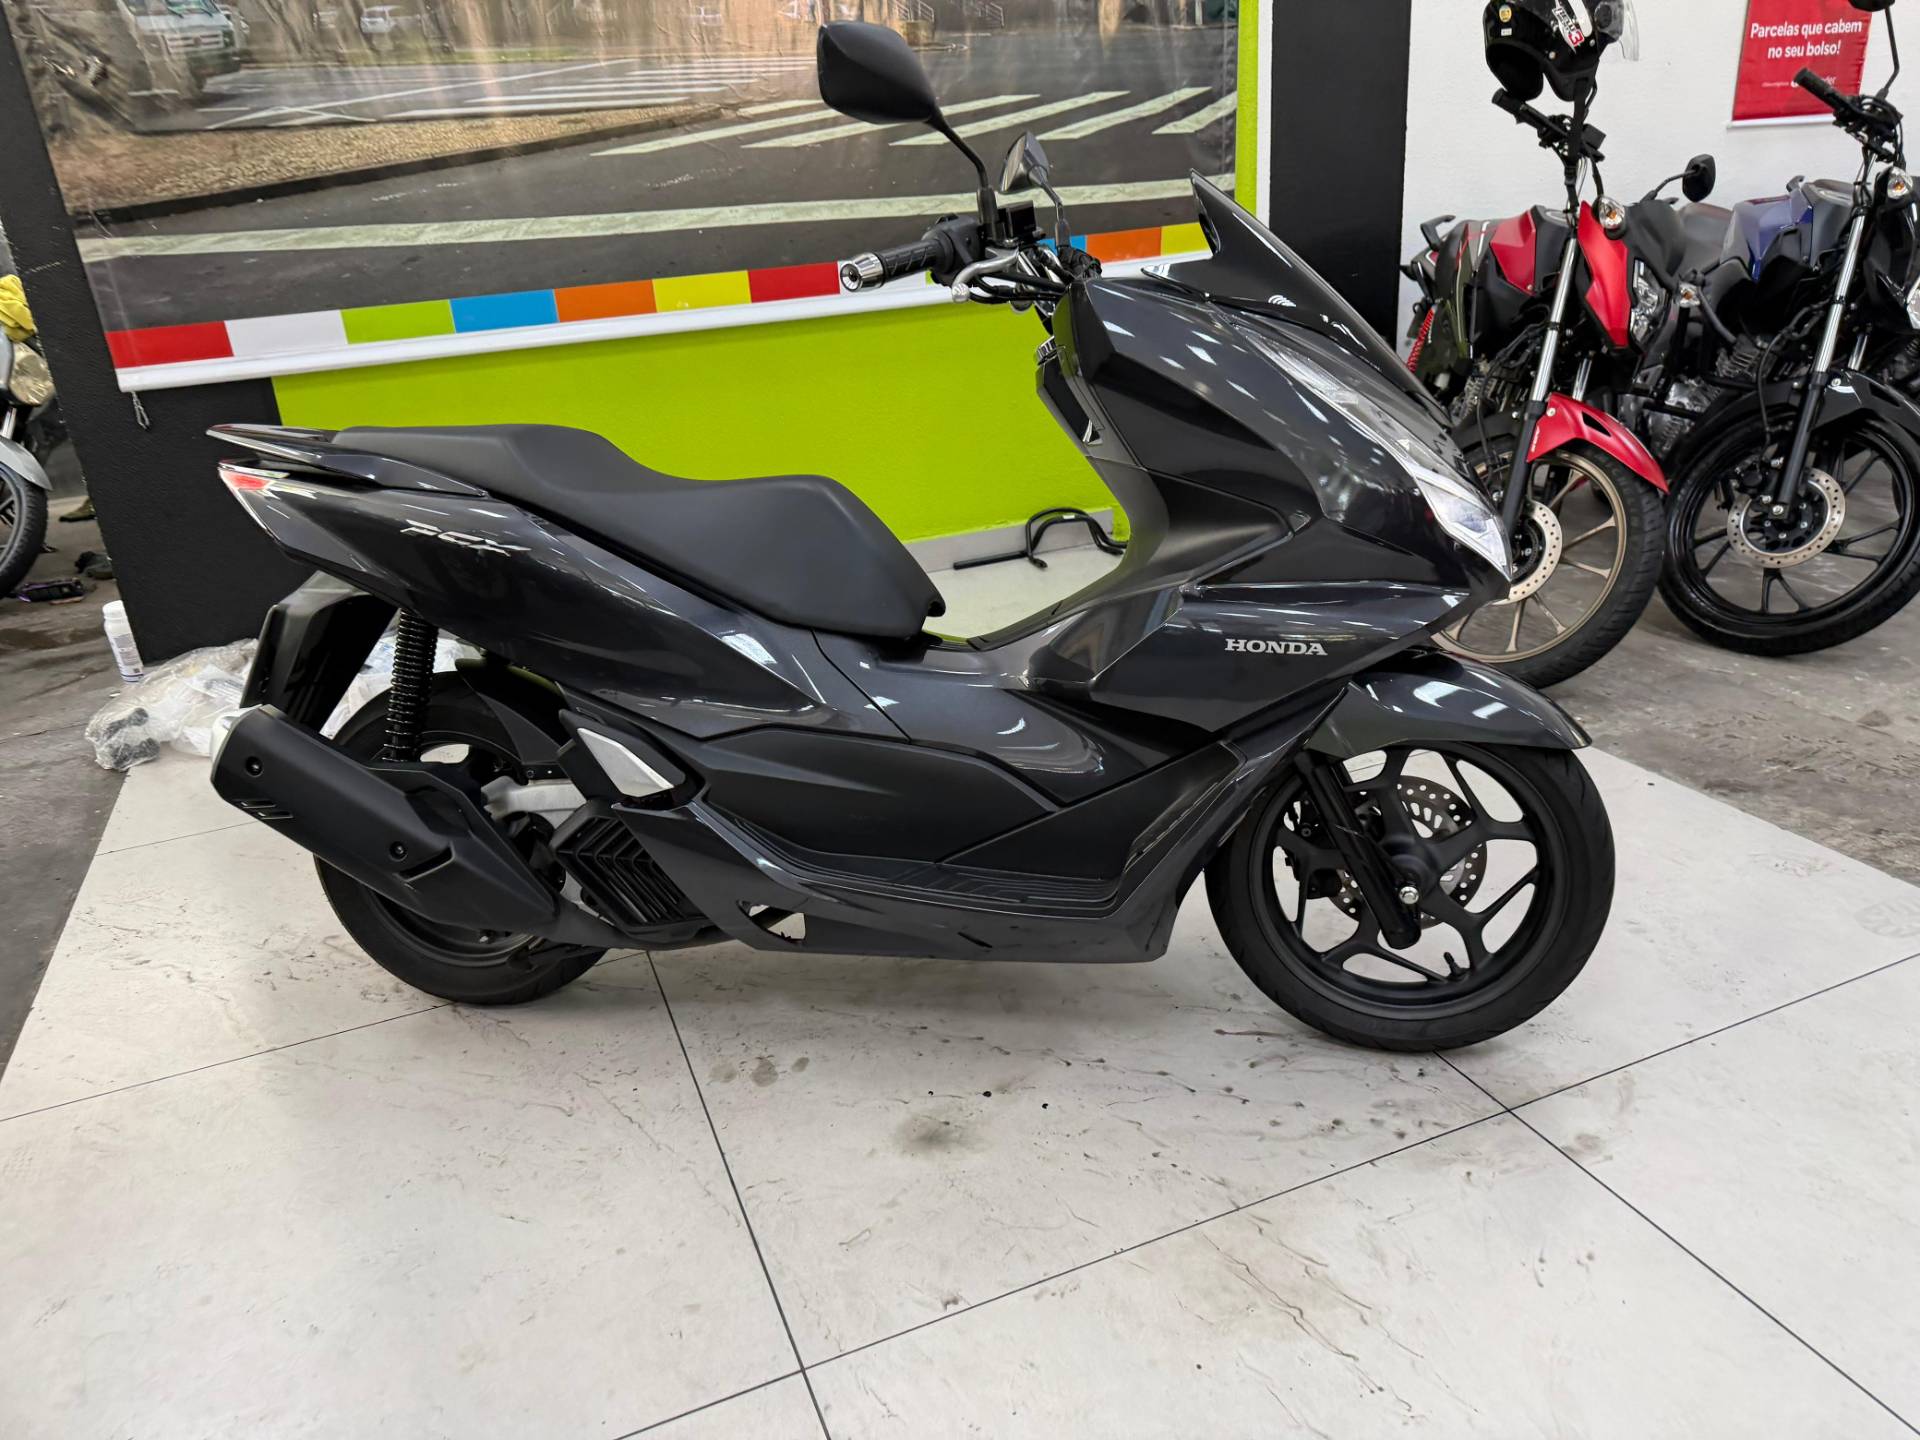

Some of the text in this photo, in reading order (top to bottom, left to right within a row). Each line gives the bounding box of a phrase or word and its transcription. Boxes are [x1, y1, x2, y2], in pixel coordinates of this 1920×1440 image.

[1750, 18, 1863, 39] Parcelas que cabem
[1767, 39, 1842, 59] no seu bolso!
[400, 519, 532, 557] PCX
[1224, 638, 1328, 656] HONDA
